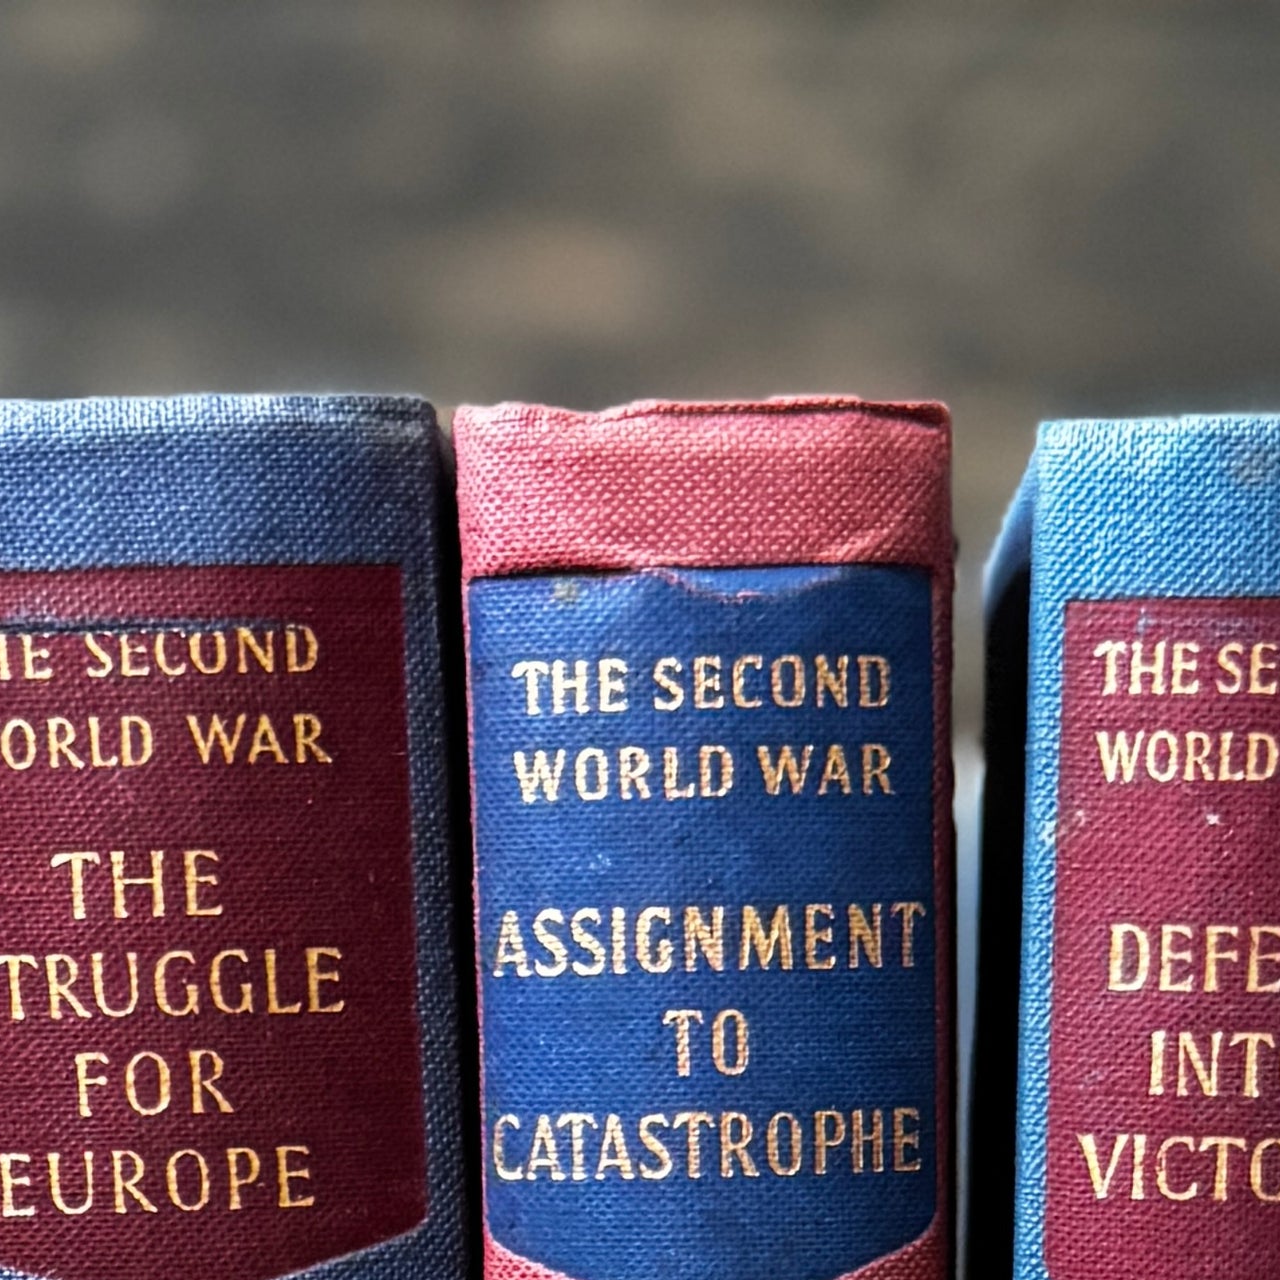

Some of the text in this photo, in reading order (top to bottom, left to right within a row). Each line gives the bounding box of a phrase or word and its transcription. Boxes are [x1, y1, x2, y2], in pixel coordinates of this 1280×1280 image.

[85, 624, 320, 679] SECOND
[1094, 640, 1200, 696] THE
[512, 654, 890, 716] THE SECOND
[186, 713, 333, 765] WAR
[1096, 730, 1279, 784] WORLD
[514, 744, 896, 803] WORLD WAR
[51, 850, 223, 919] THE
[493, 901, 926, 978] ASSIGNMENT
[663, 1009, 749, 1078] TO
[76, 1049, 234, 1117] FOR
[493, 1107, 922, 1182] CATASTROPHE
[0, 1145, 315, 1219] EUROPE
